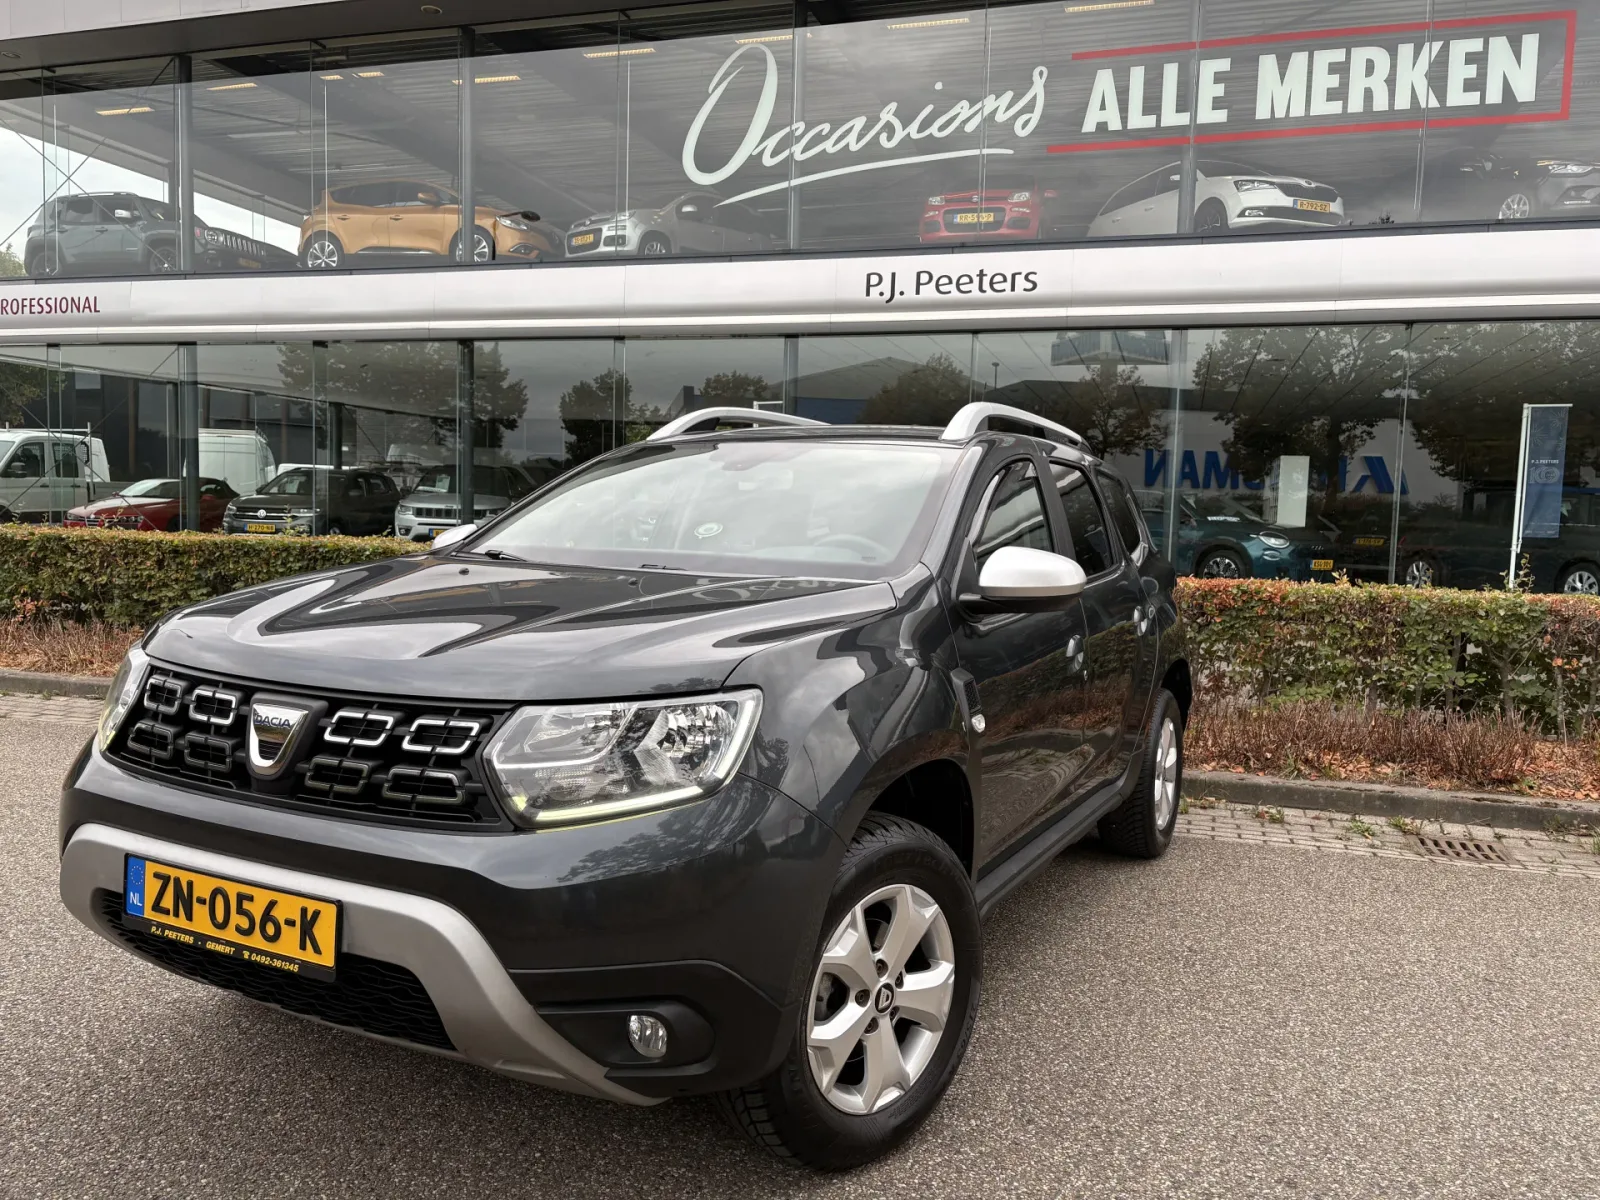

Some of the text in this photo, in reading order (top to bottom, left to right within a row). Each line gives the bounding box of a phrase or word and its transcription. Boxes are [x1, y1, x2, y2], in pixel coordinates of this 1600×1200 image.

[1081, 33, 1540, 132] ALLE MERKEN
[682, 43, 1048, 185] Occasions
[0, 296, 101, 315] ROFESSIONAL
[865, 268, 1038, 304] P.J. Peeters
[254, 713, 292, 729] DACIA
[129, 891, 143, 907] NL
[151, 871, 323, 955] ZN-056-K
[150, 925, 299, 972] P.J. PEETERS GEMERT 0492-361345
